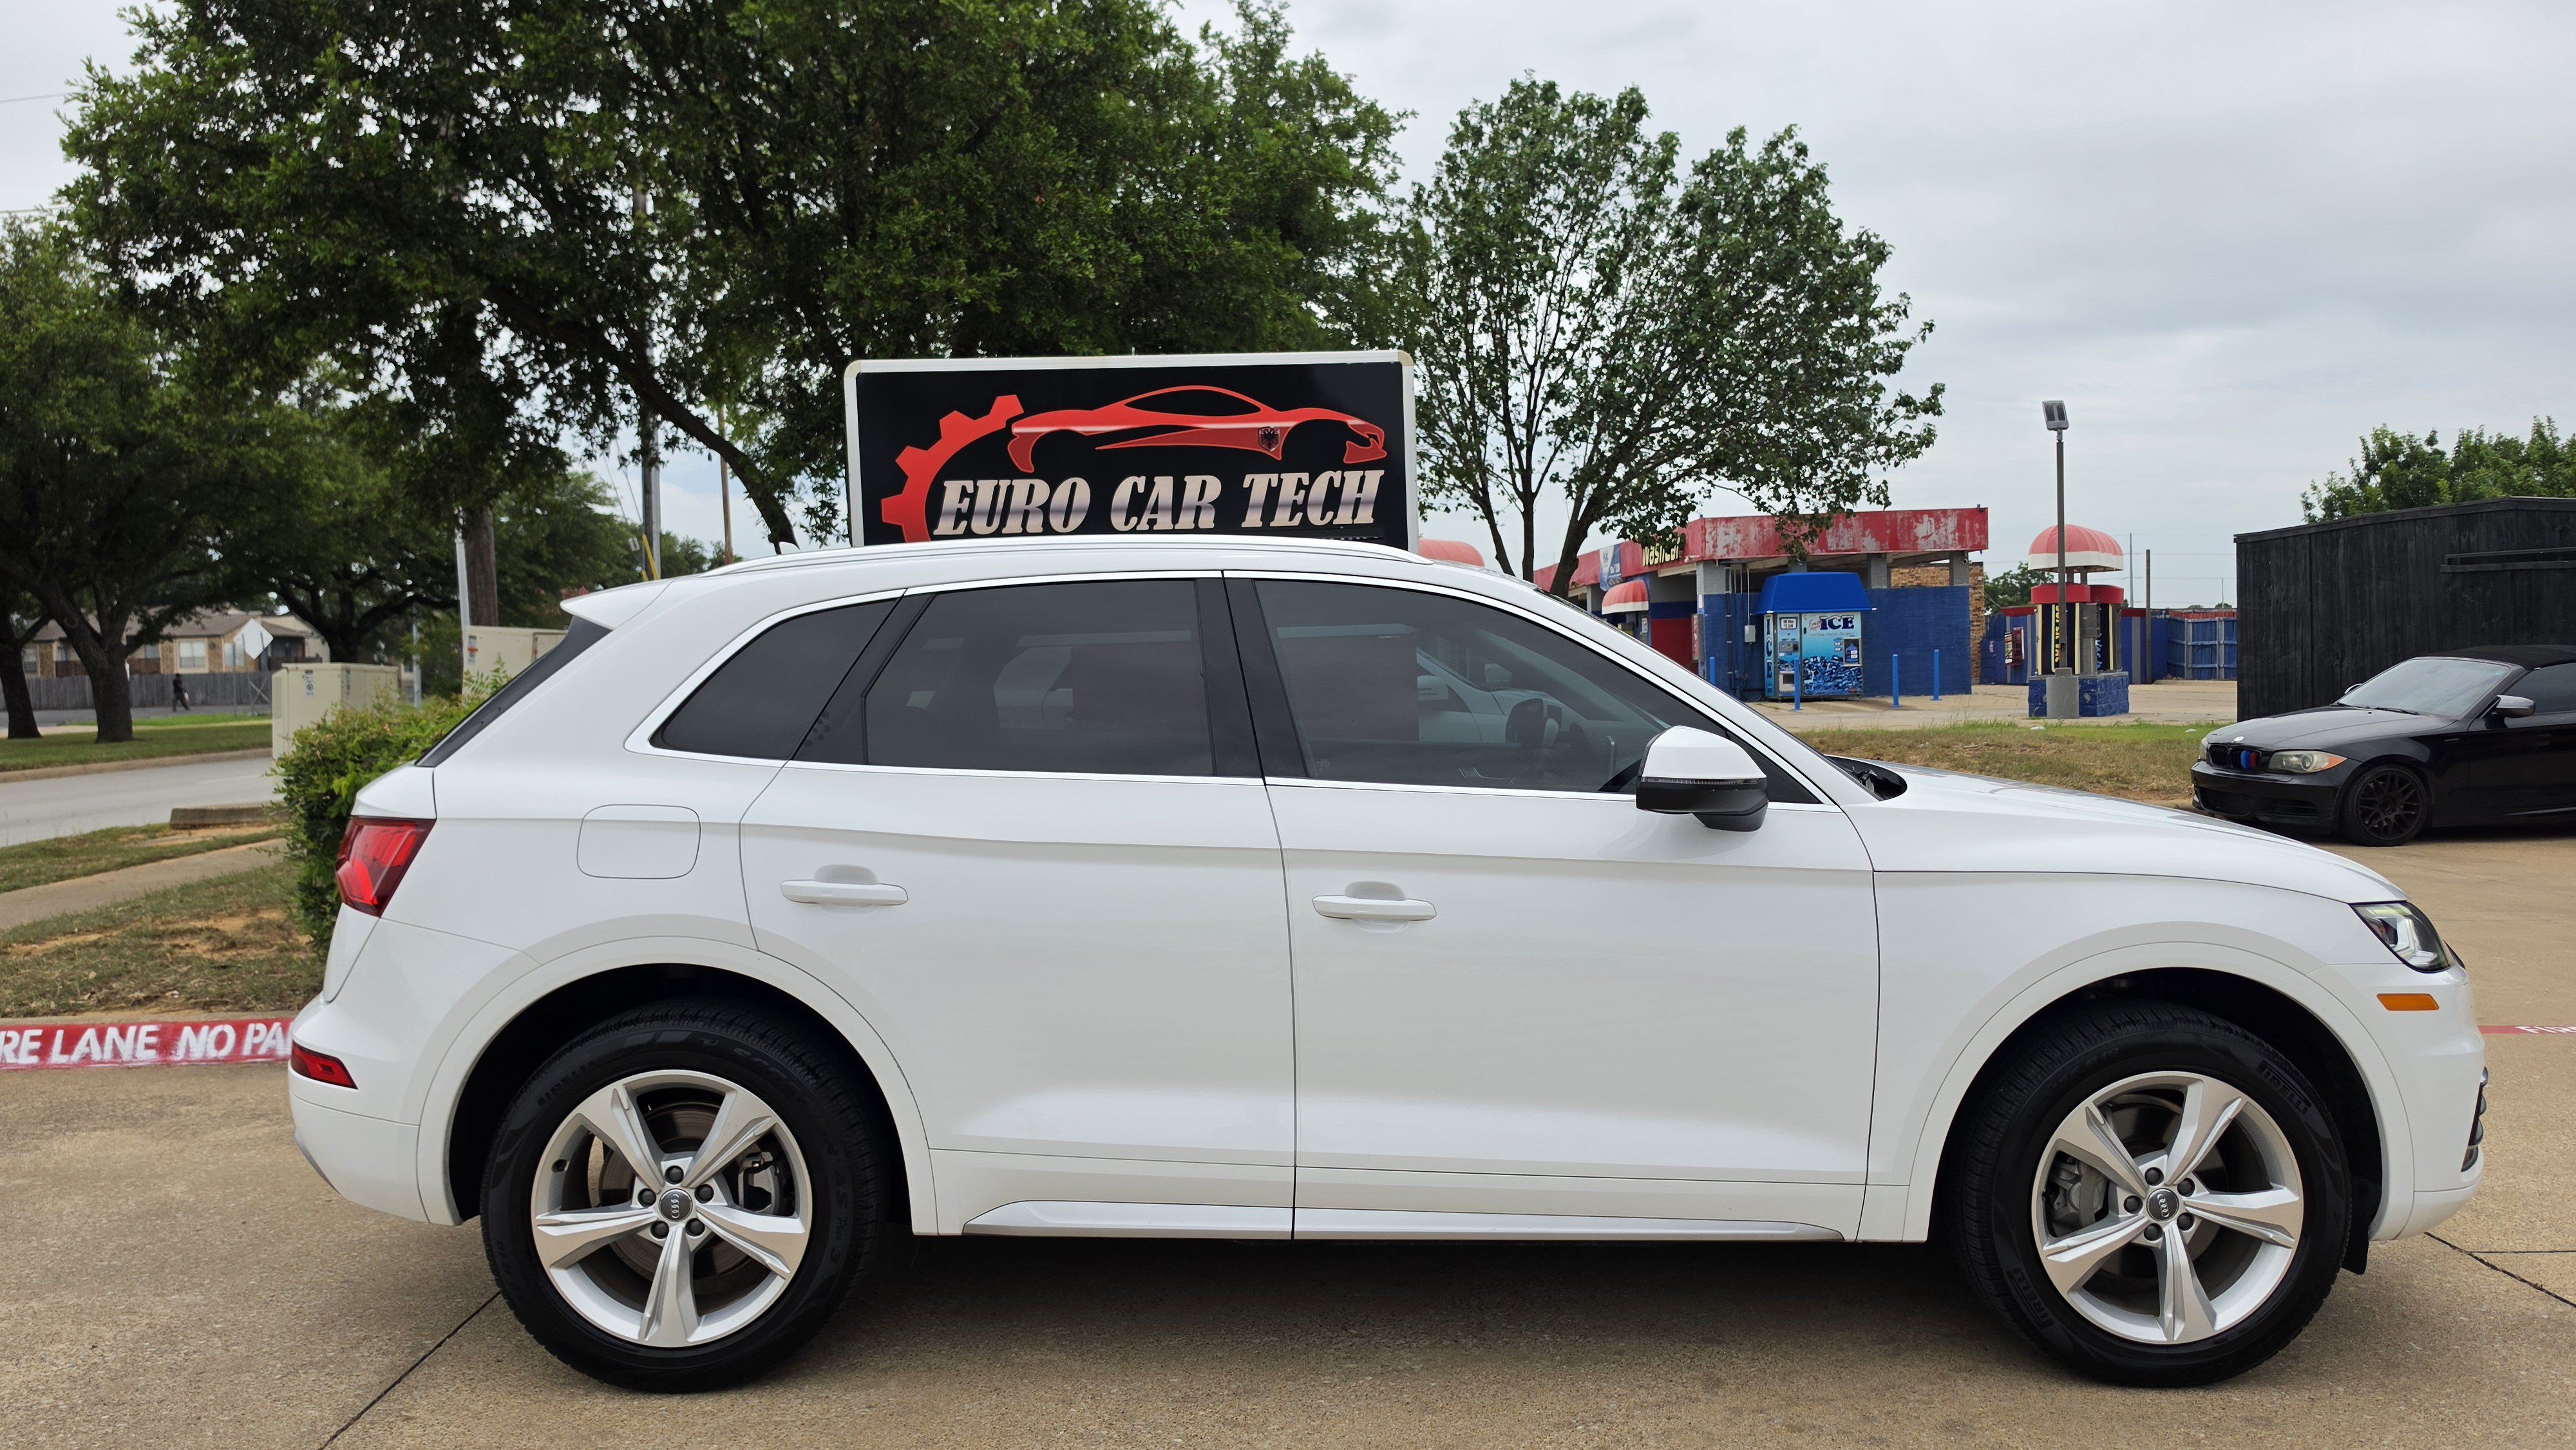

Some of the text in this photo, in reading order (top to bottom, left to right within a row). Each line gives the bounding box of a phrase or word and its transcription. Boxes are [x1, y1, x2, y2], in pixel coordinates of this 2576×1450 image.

[933, 470, 1385, 536] EURO CAR TECH
[1819, 615, 1854, 630] ICE
[49, 1025, 160, 1063] LANE
[176, 1023, 236, 1059] NO
[2255, 1059, 2312, 1115] PIRELLI
